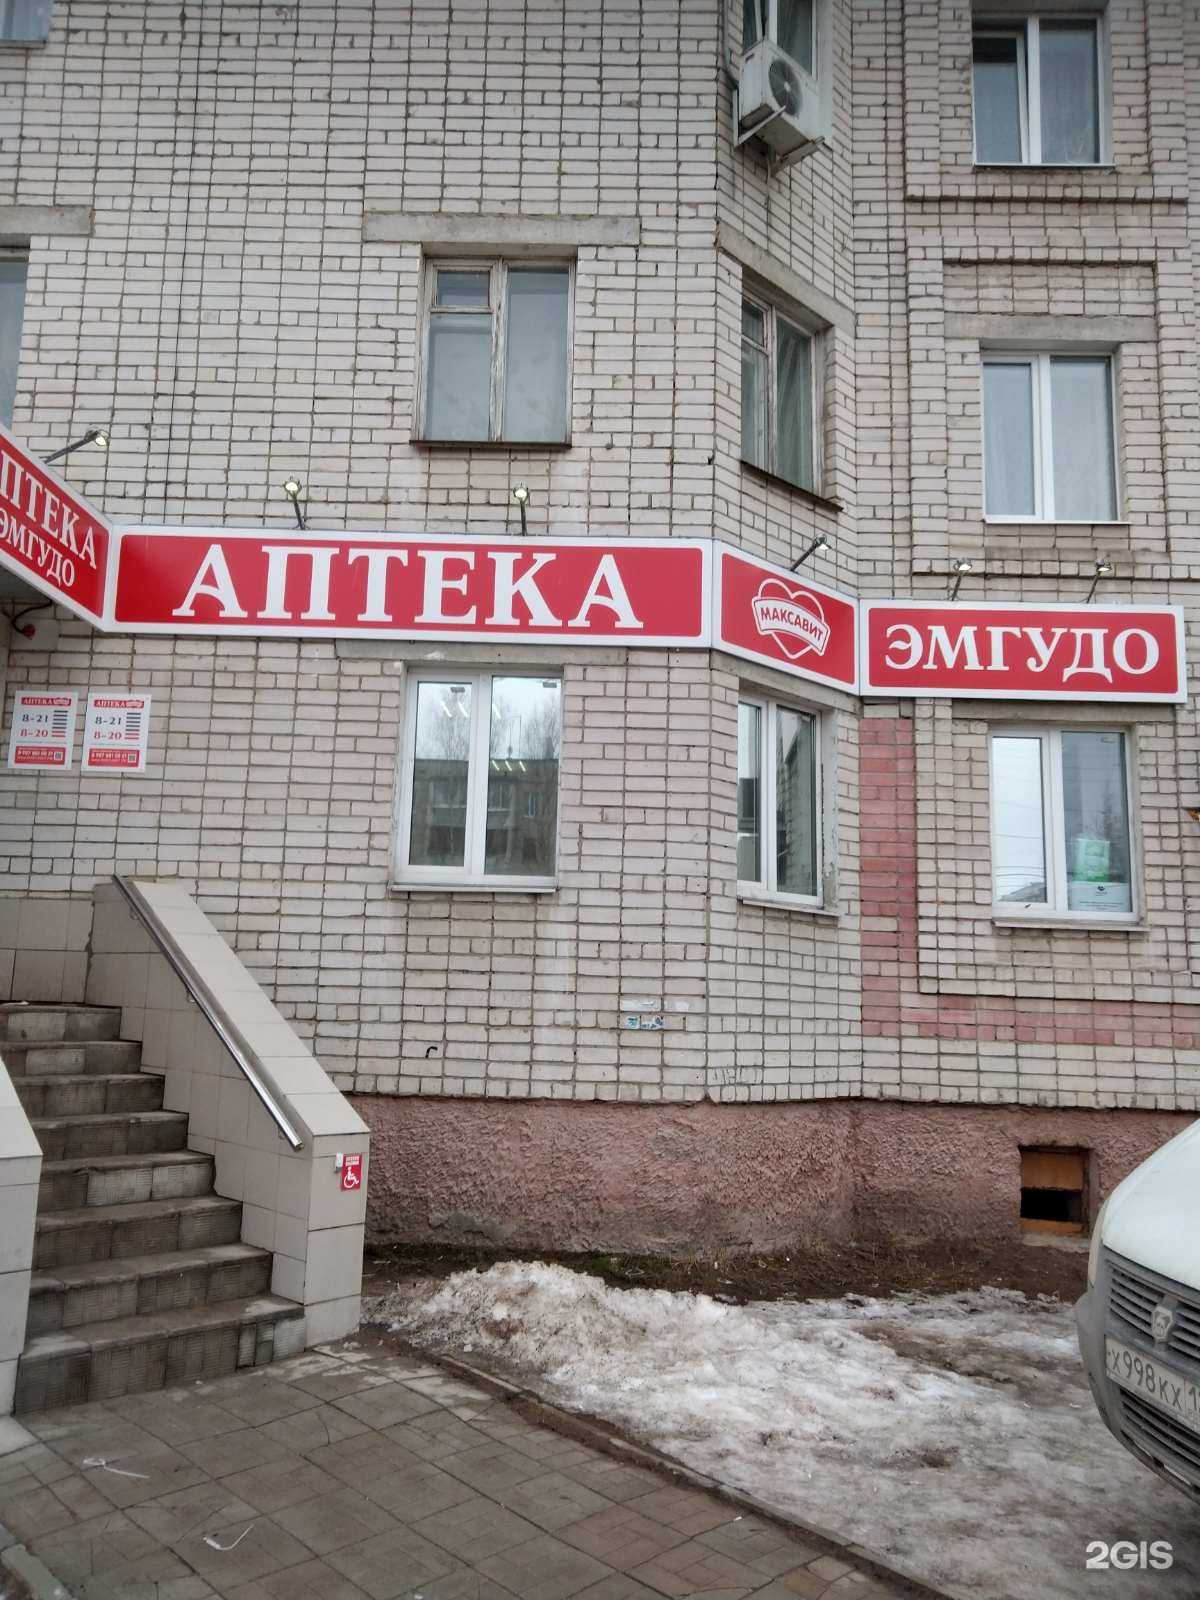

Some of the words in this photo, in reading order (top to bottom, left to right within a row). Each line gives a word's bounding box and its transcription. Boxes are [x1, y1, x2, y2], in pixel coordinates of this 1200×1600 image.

[172, 543, 644, 629] АПТЕКА
[760, 606, 823, 641] МАКСАВИТ
[885, 623, 1160, 684] ЭМГУДО
[95, 716, 122, 725] 8-21
